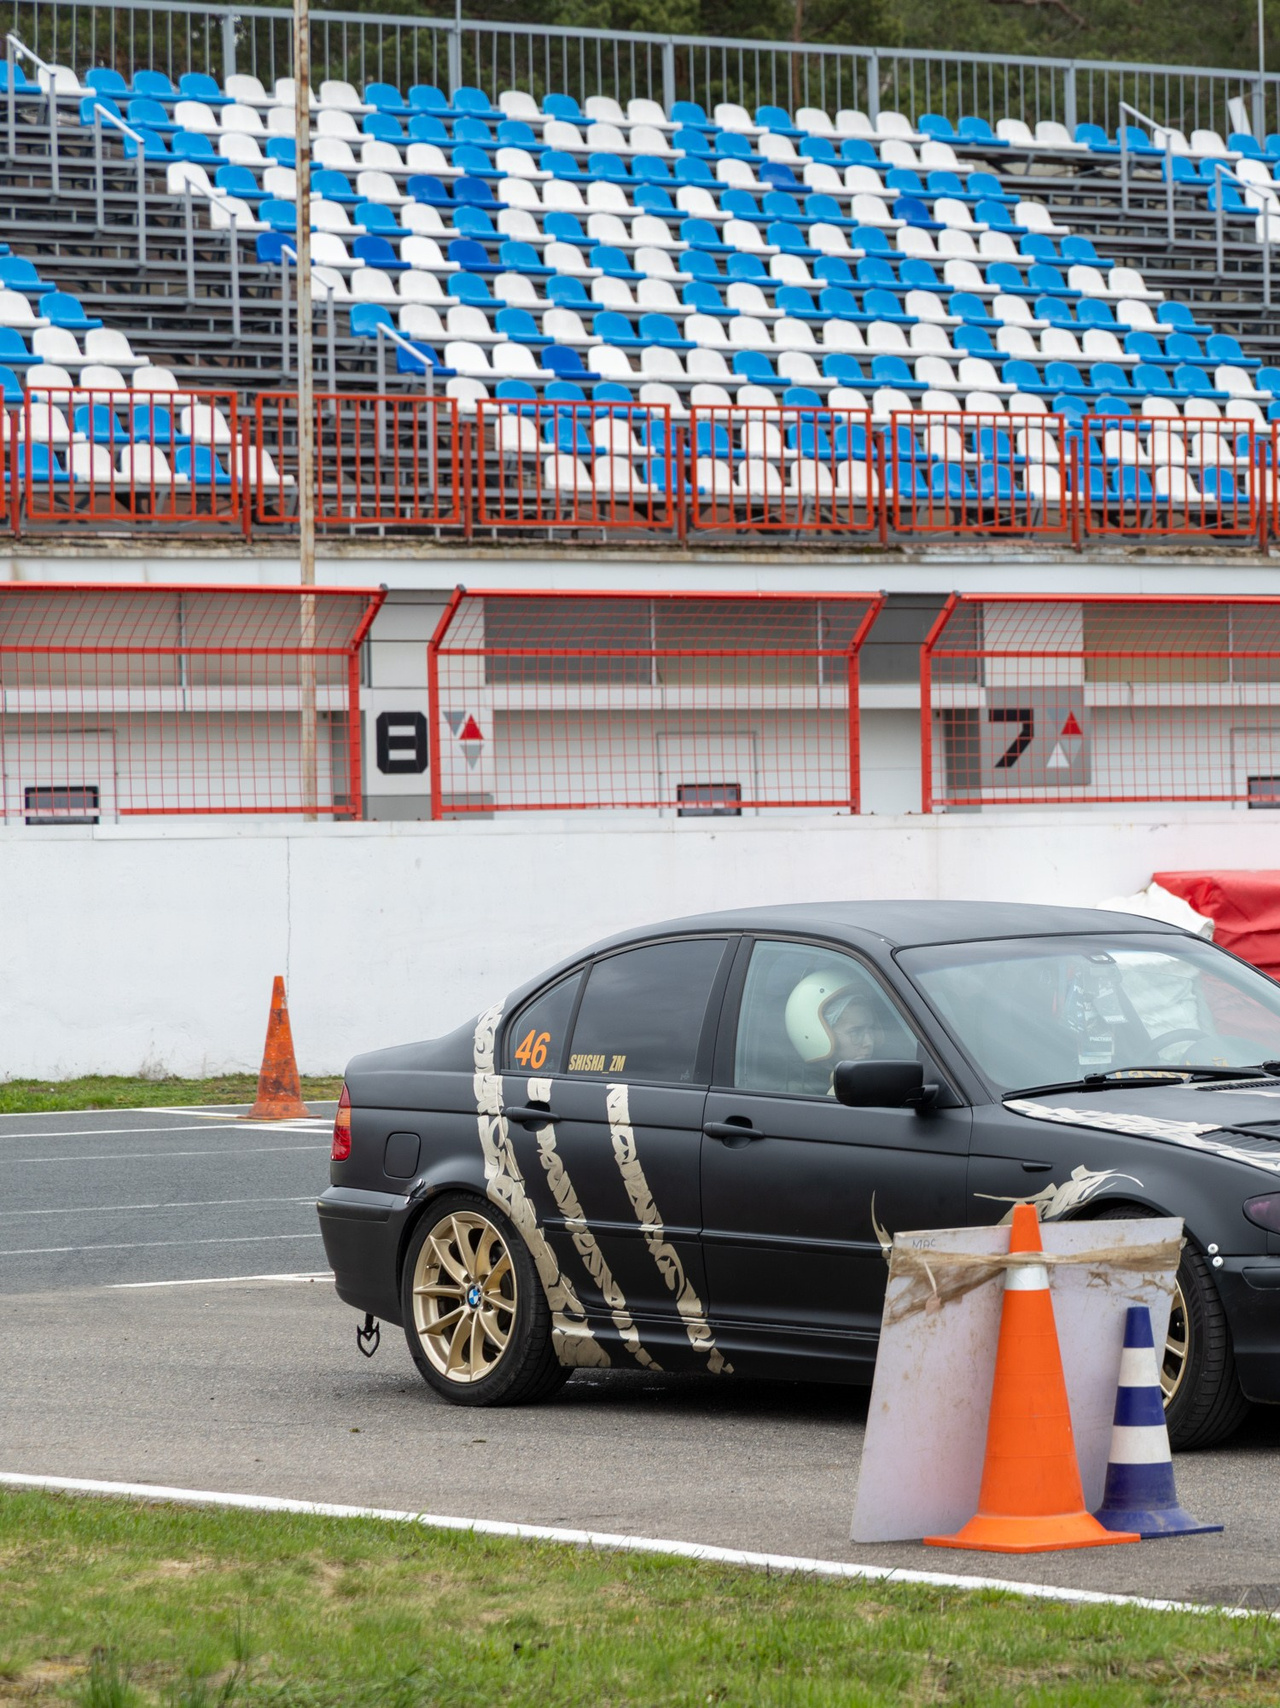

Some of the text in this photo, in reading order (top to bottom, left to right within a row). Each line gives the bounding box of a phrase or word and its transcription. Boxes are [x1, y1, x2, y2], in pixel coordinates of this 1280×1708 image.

[376, 711, 428, 775] 8
[988, 708, 1034, 768] 7
[514, 1029, 551, 1069] 46
[568, 1054, 627, 1074] SHISHA_ZM
